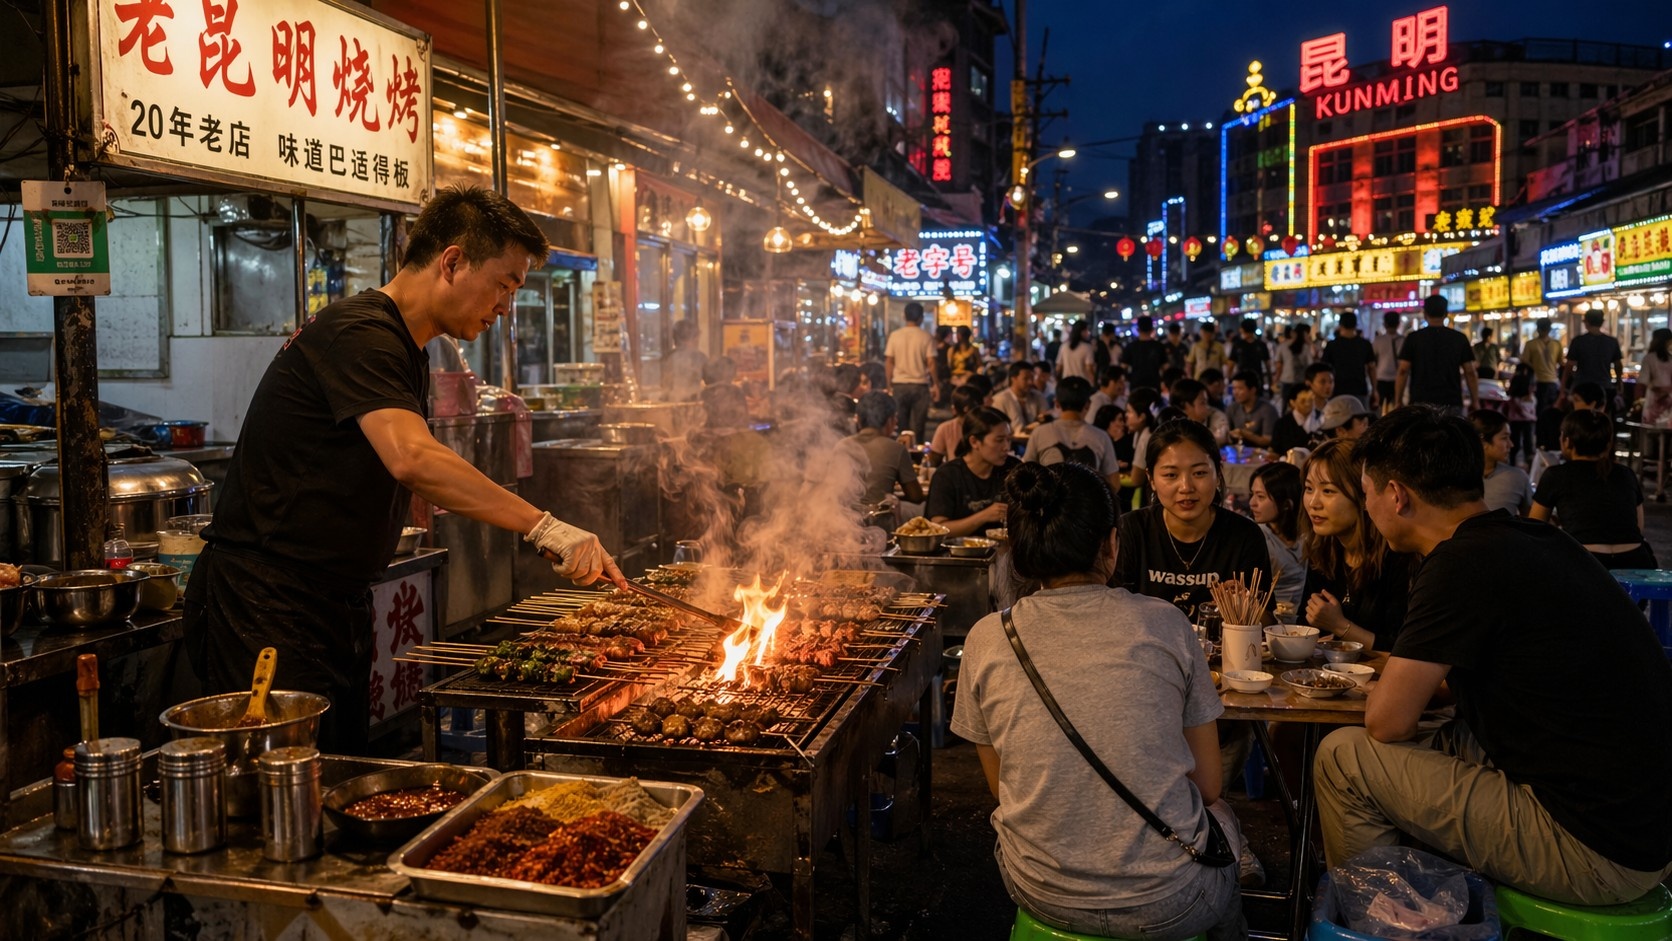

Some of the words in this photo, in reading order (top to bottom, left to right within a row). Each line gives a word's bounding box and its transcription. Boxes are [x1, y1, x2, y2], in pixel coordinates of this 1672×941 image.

[115, 0, 421, 144] 老昆明烧烤
[1300, 6, 1448, 92] 昆明
[1316, 67, 1458, 118] KUNMING
[131, 99, 251, 158] 20年老店
[279, 133, 410, 188] 味道巴适得板
[893, 243, 977, 279] 老字号
[1148, 569, 1219, 588] wassup
